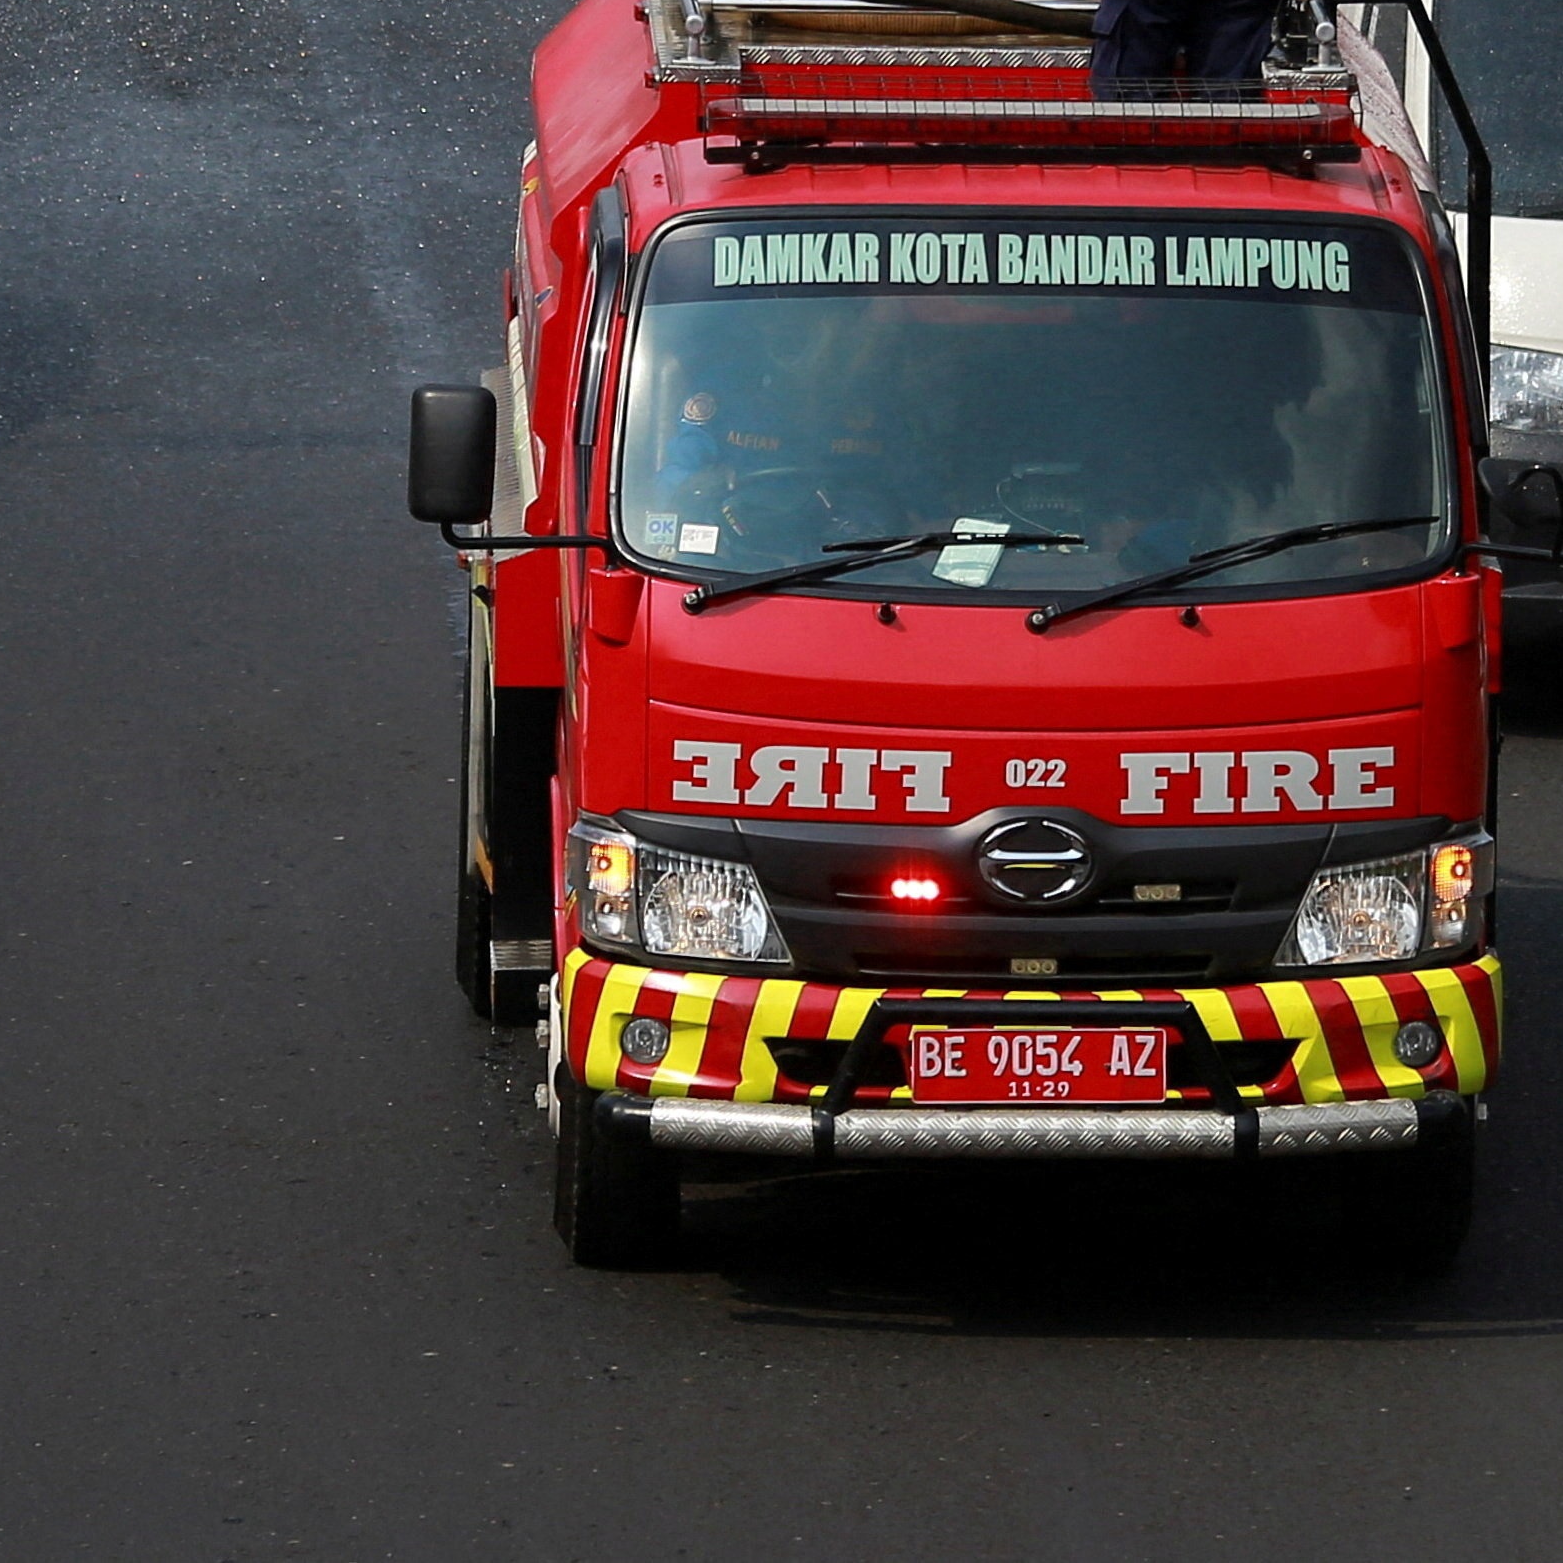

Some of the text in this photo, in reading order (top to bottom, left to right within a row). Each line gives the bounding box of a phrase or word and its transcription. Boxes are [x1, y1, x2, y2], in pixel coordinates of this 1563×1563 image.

[713, 233, 1351, 292] DAMKAR KOTA BANDAR LAMPUNG
[648, 520, 675, 535] OK
[1005, 758, 1067, 789] 022
[1120, 746, 1395, 816] FIRE
[919, 1034, 1158, 1078] BE 9054 AZ
